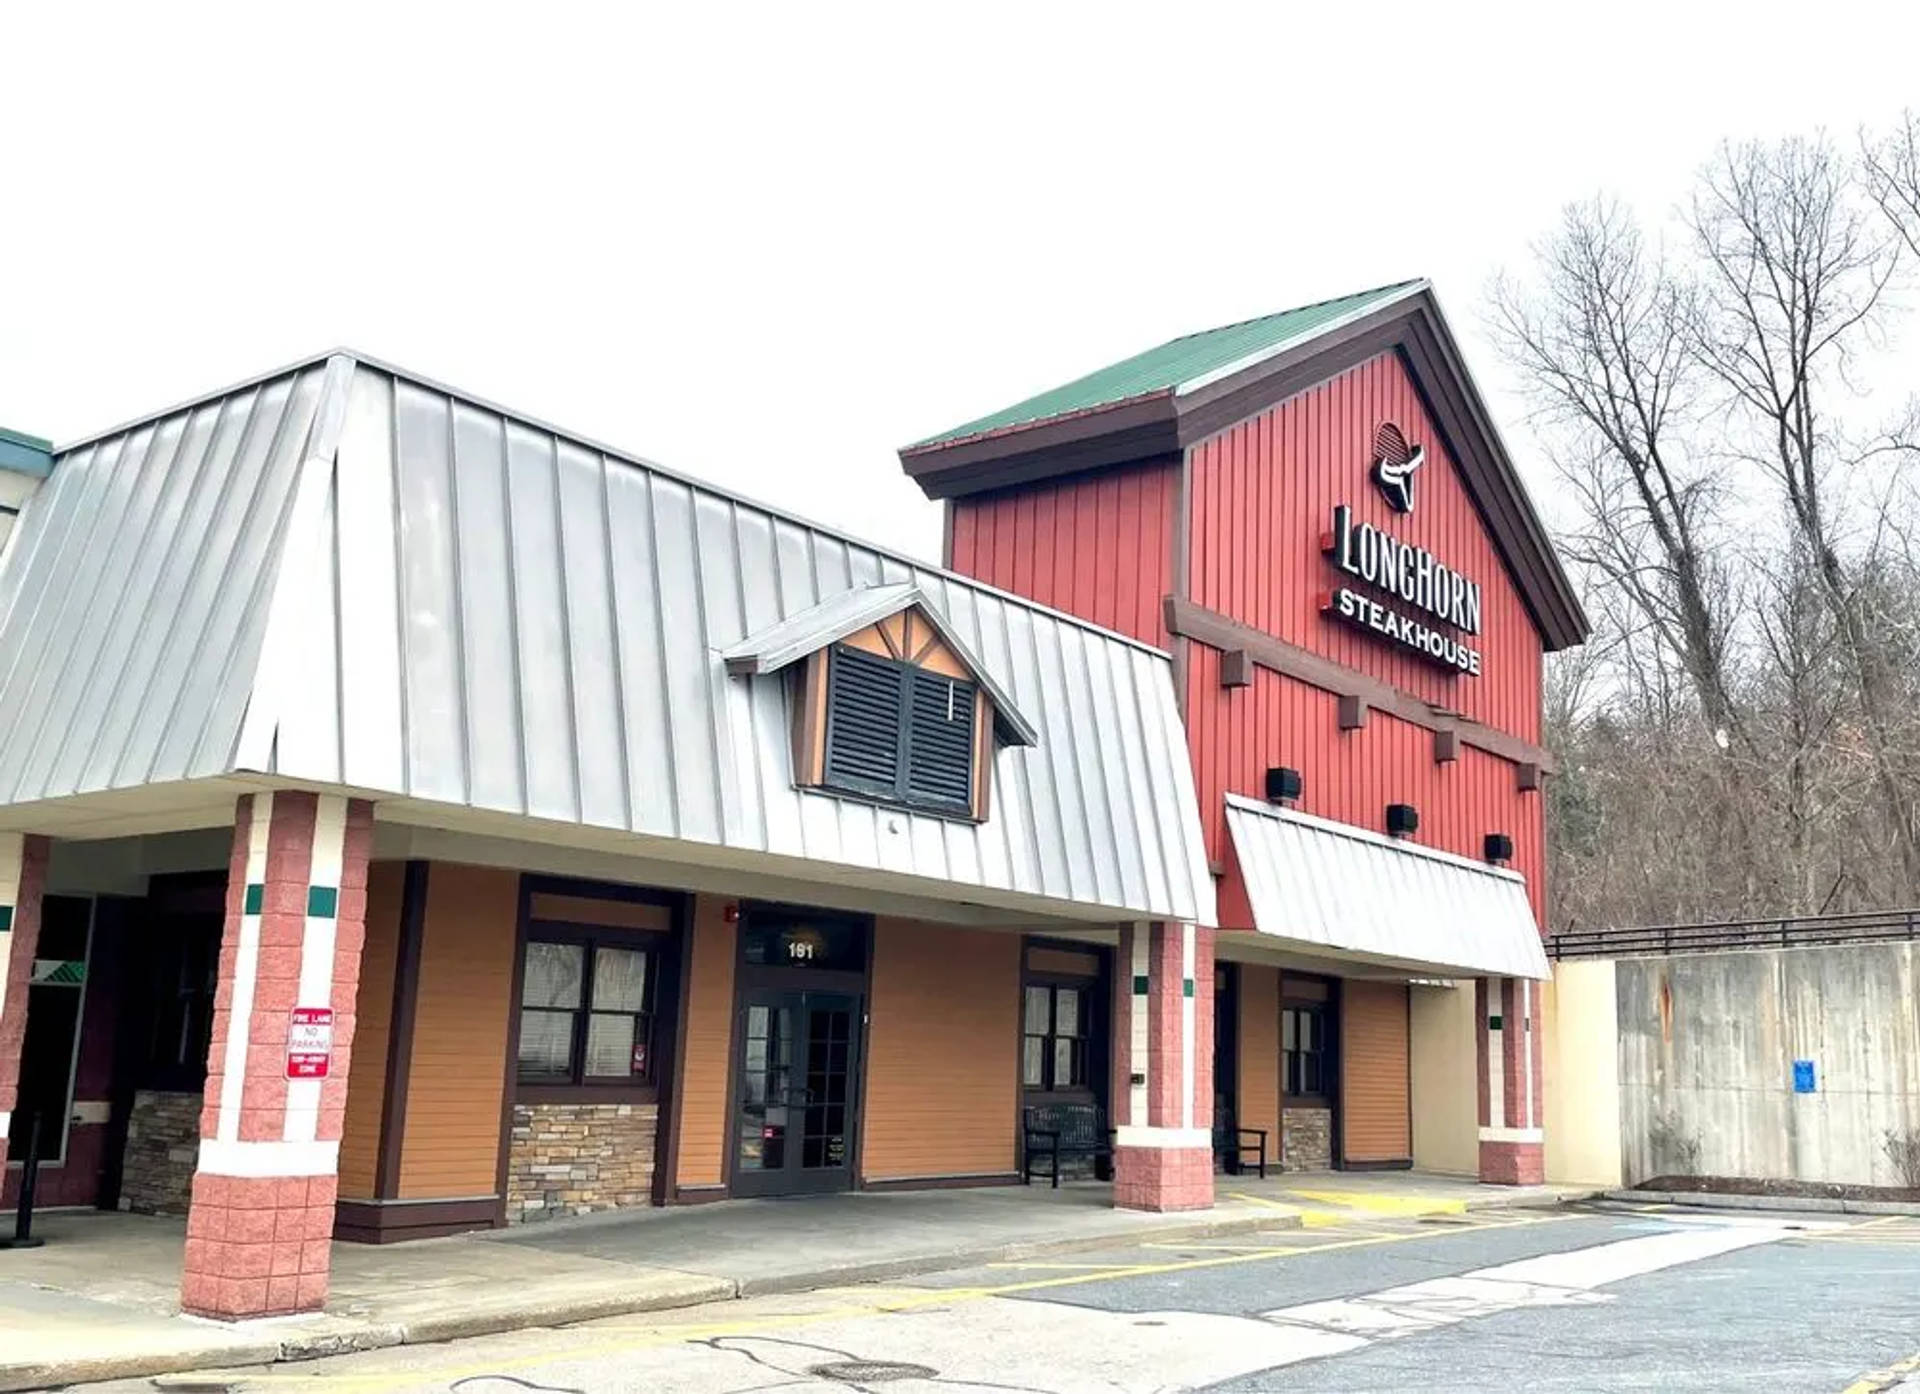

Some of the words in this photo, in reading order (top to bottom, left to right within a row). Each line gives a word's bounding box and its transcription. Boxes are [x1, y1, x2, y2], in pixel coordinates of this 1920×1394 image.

[1335, 505, 1480, 635] LONGHORN
[1339, 588, 1480, 676] STEAKHOUSE
[291, 1039, 329, 1049] PARKING
[304, 1027, 318, 1037] NO
